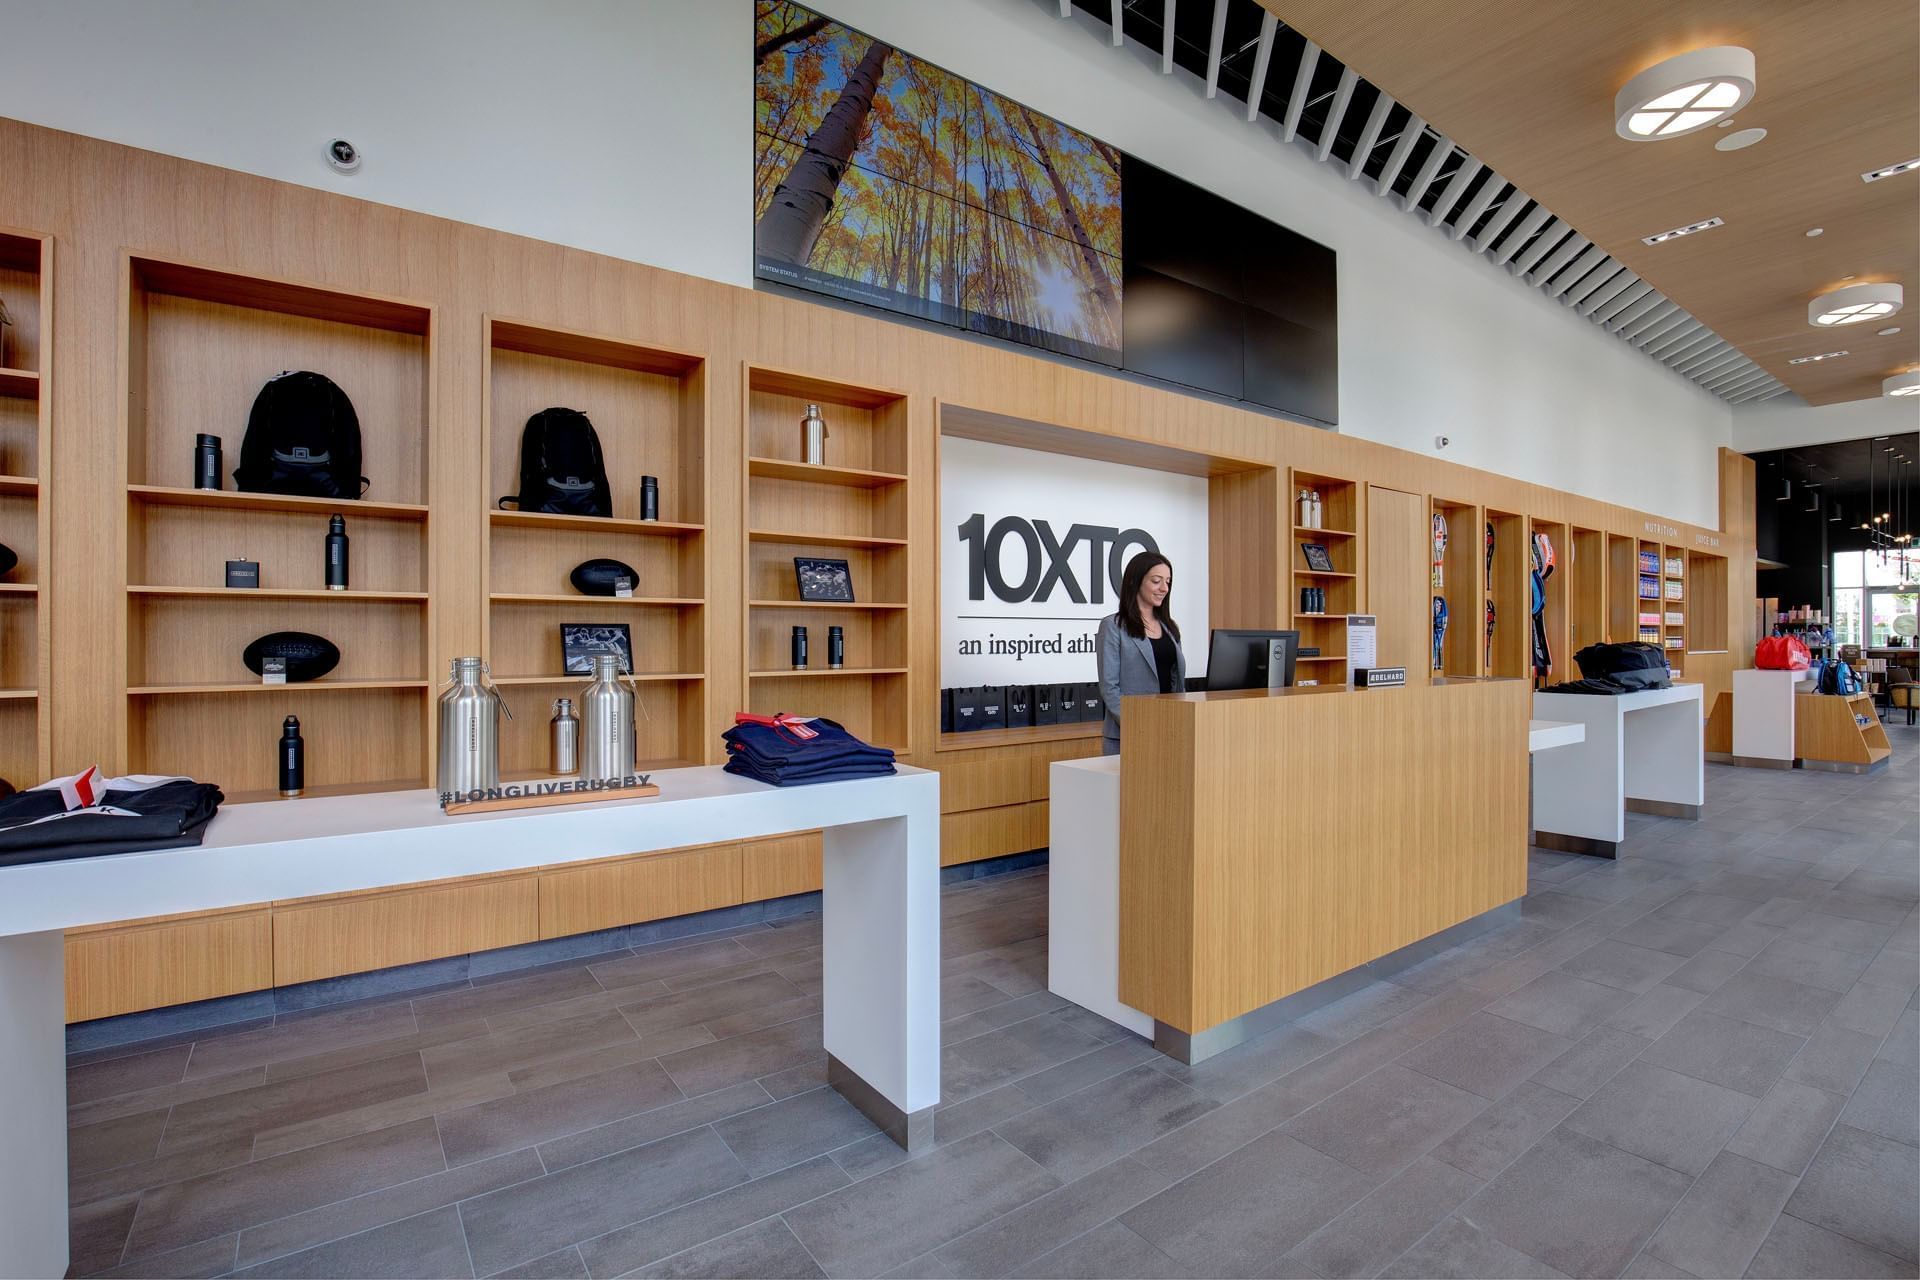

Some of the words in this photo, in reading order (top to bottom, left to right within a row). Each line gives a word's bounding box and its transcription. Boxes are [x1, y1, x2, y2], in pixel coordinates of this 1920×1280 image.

[759, 263, 779, 274] SYSTEM
[780, 267, 798, 279] STATUS
[1644, 521, 1678, 537] NUTRITION
[957, 513, 1161, 604] 10XTO
[958, 639, 982, 655] an
[989, 633, 1062, 661] inspired
[440, 774, 652, 807] #LONGLIVERUGBY
